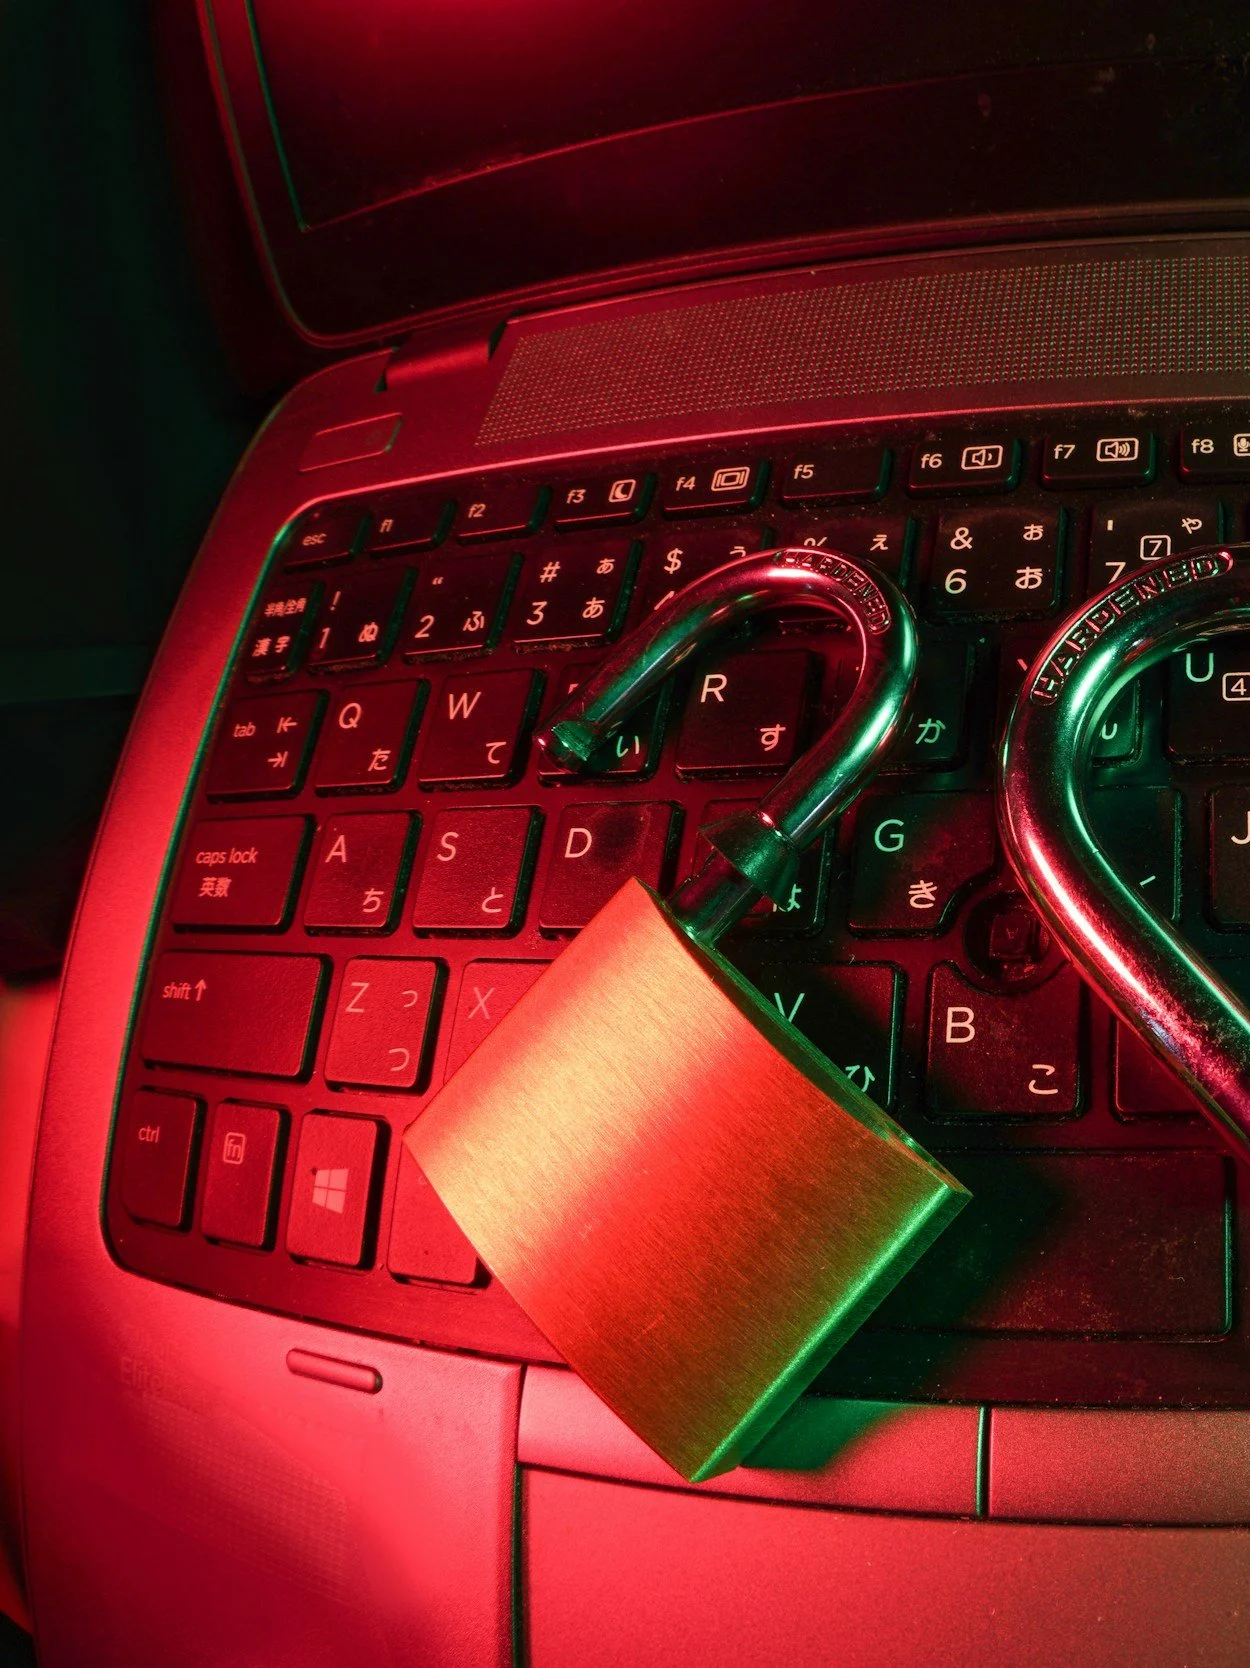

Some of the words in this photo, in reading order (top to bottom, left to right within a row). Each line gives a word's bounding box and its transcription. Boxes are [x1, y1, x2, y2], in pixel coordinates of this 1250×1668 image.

[1054, 444, 1075, 459] f7
[1192, 439, 1214, 453] f8
[794, 464, 814, 479] f5
[921, 453, 942, 468] f6
[676, 476, 695, 491] f4
[567, 489, 586, 503] f3
[468, 504, 486, 518] f2
[380, 519, 393, 532] f1
[302, 533, 326, 546] esc
[950, 527, 972, 550] &
[540, 561, 560, 583] #
[664, 548, 683, 574] $
[945, 569, 967, 594] 6
[1015, 567, 1043, 589] お
[1105, 562, 1126, 584] 7
[330, 591, 341, 611] !
[582, 597, 605, 618] あ
[463, 611, 484, 631] ふ
[527, 601, 547, 625] 3
[358, 622, 378, 642] ぬ
[415, 615, 434, 638] 2
[1032, 557, 1221, 700] HARDENED
[318, 627, 330, 649] 1
[1186, 653, 1214, 682] U
[701, 674, 727, 702] R
[339, 703, 362, 729] Q
[449, 692, 481, 719] W
[233, 722, 256, 737] tab
[760, 724, 786, 751] す
[916, 718, 946, 744] か
[486, 742, 506, 764] て
[616, 735, 641, 757] い
[368, 749, 391, 771] た
[437, 832, 459, 861] S
[565, 828, 592, 858] D
[875, 819, 904, 852] G
[196, 852, 227, 866] caps
[229, 847, 258, 863] lock
[325, 835, 346, 863] A
[199, 877, 232, 897] 英数
[908, 880, 937, 908] き
[363, 888, 384, 912] ち
[481, 887, 503, 913] と
[163, 982, 192, 1000] shift
[345, 982, 371, 1013] Z
[467, 986, 496, 1019] X
[774, 993, 806, 1023] V
[946, 1007, 975, 1043] B
[389, 1048, 412, 1071] つ
[1029, 1064, 1058, 1094] こ
[138, 1125, 160, 1143] ctrl
[227, 1139, 242, 1159] fn
